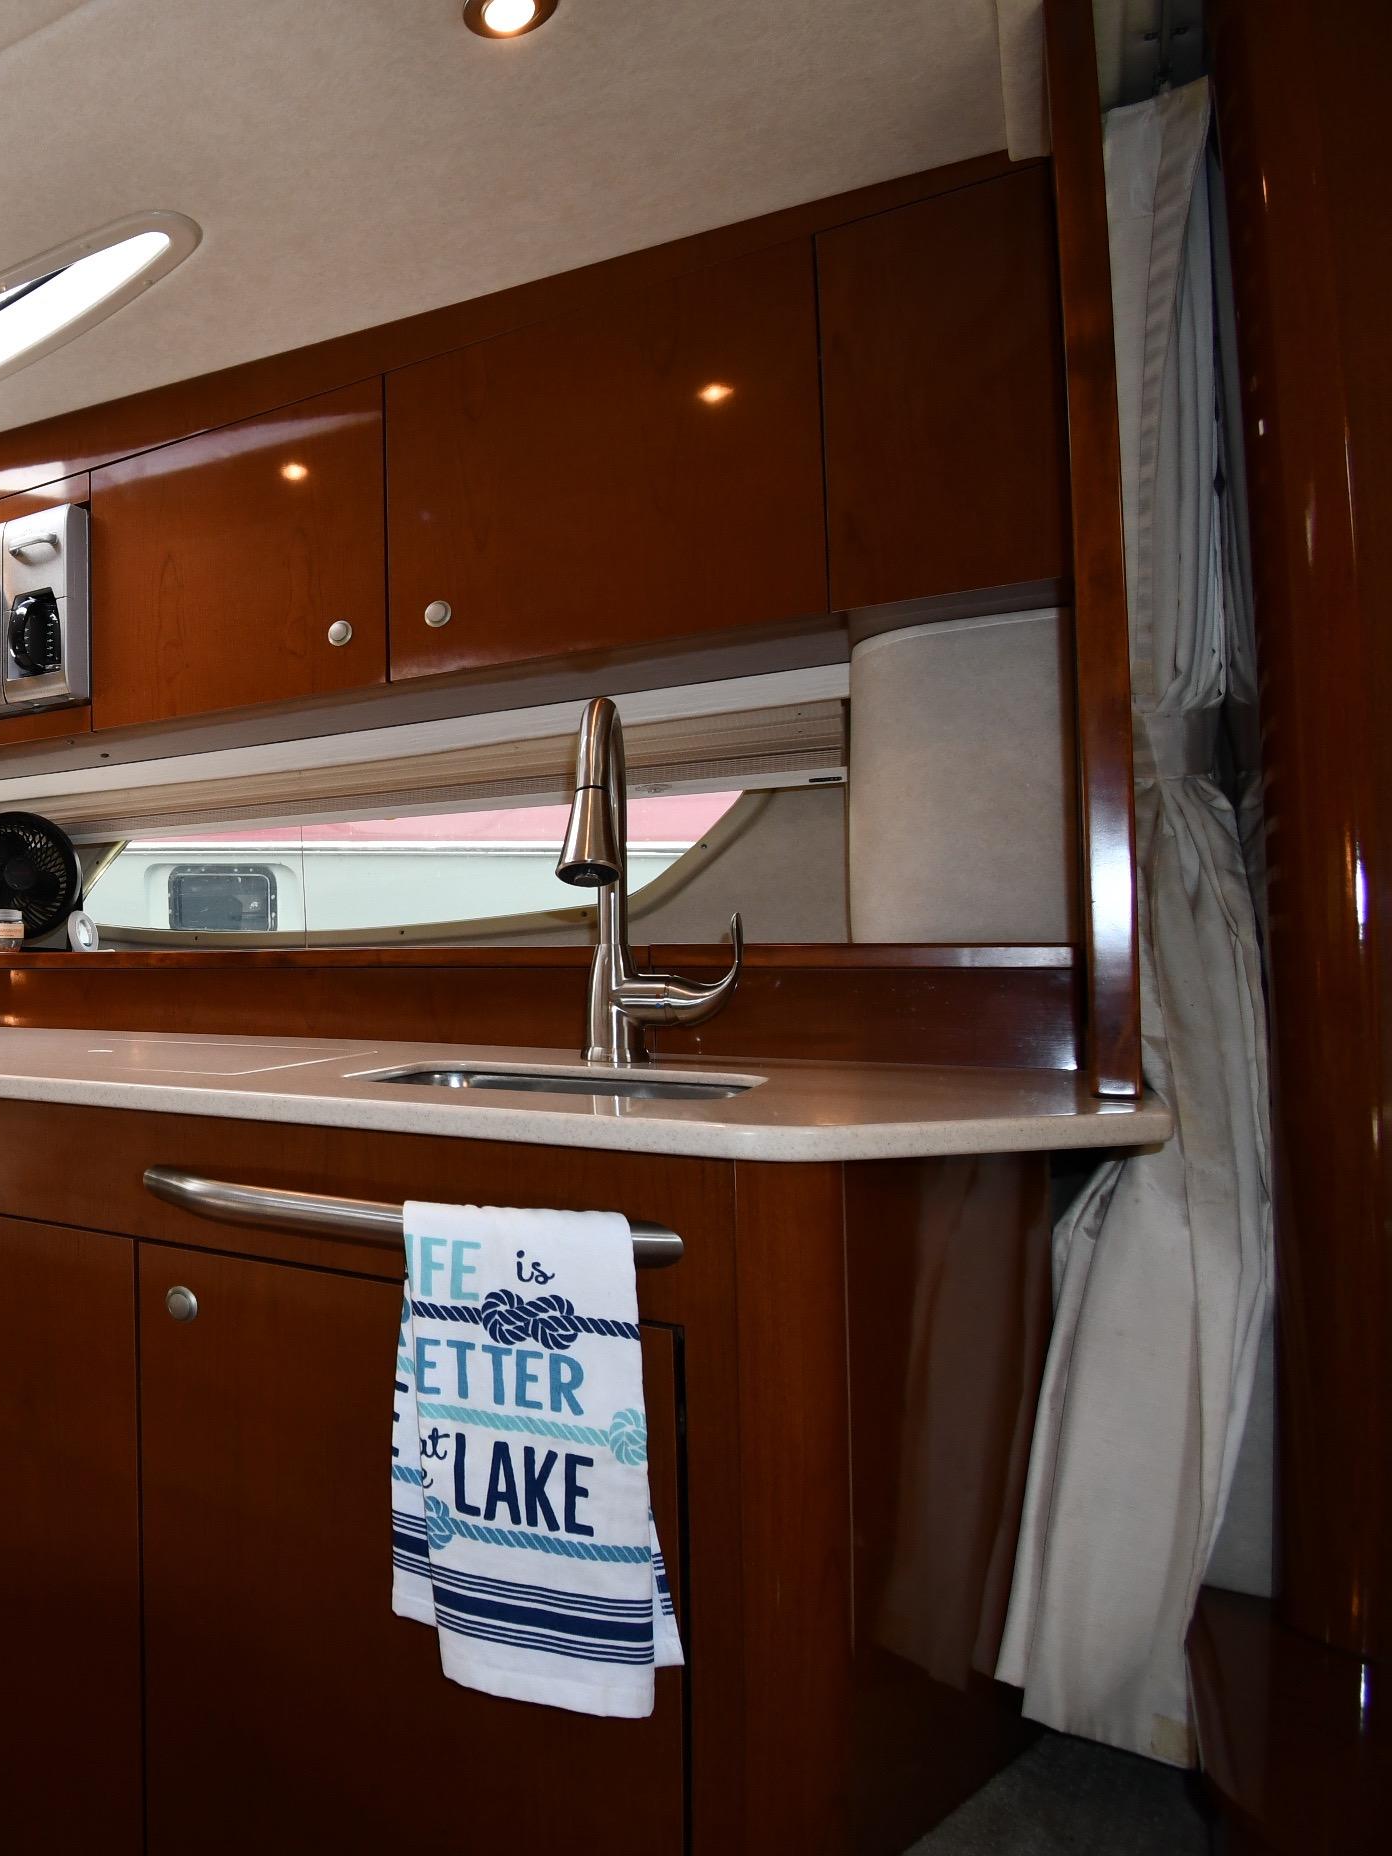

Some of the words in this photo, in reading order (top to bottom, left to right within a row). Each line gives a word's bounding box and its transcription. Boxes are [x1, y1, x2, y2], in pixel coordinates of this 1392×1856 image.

[405, 1233, 481, 1301] IFE
[516, 1250, 555, 1285] is
[416, 1337, 584, 1416] ETTER
[454, 1432, 594, 1537] LAKE
